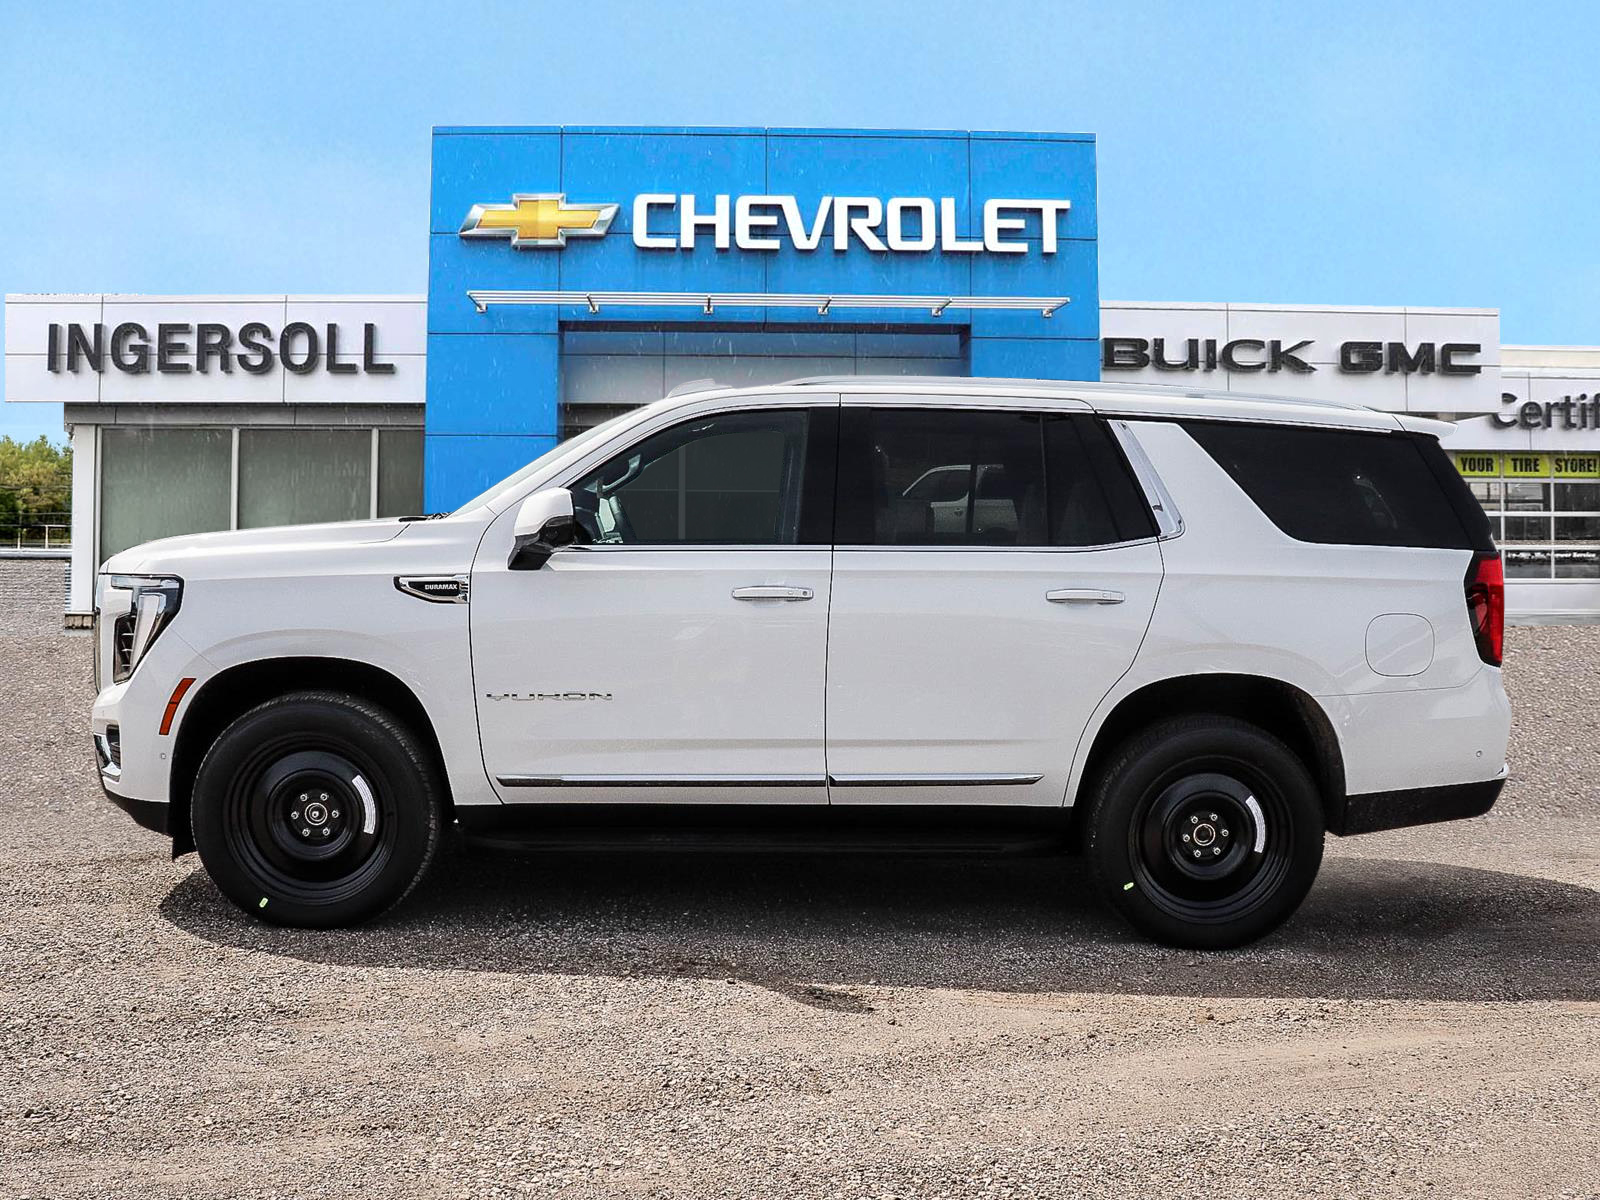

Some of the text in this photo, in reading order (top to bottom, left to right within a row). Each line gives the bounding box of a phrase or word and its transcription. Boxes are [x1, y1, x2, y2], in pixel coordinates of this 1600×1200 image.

[632, 193, 1071, 254] CHEVROLET
[47, 321, 397, 375] INGERSOLL
[1102, 337, 1482, 375] BUICK GMC
[1460, 456, 1598, 473] YOUR TIRE STORE!
[424, 583, 459, 591] DURAMAX
[486, 692, 613, 702] YUKON
